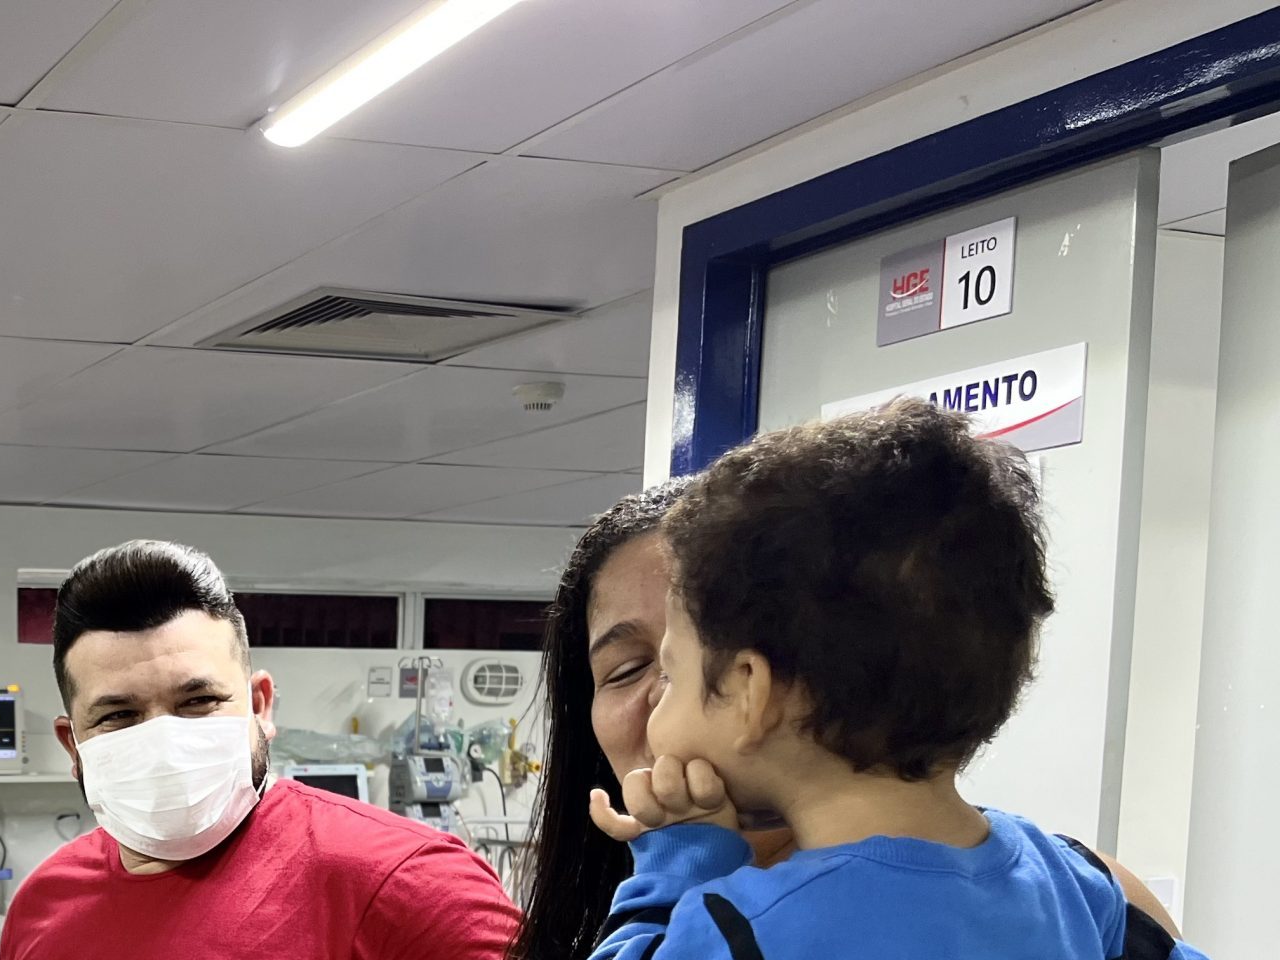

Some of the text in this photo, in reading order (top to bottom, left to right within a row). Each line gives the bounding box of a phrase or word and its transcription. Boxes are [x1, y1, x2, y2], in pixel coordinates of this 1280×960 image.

[961, 236, 997, 259] LEITO
[891, 268, 929, 300] HGE
[958, 265, 996, 310] 10
[928, 369, 1038, 413] AMENTO
